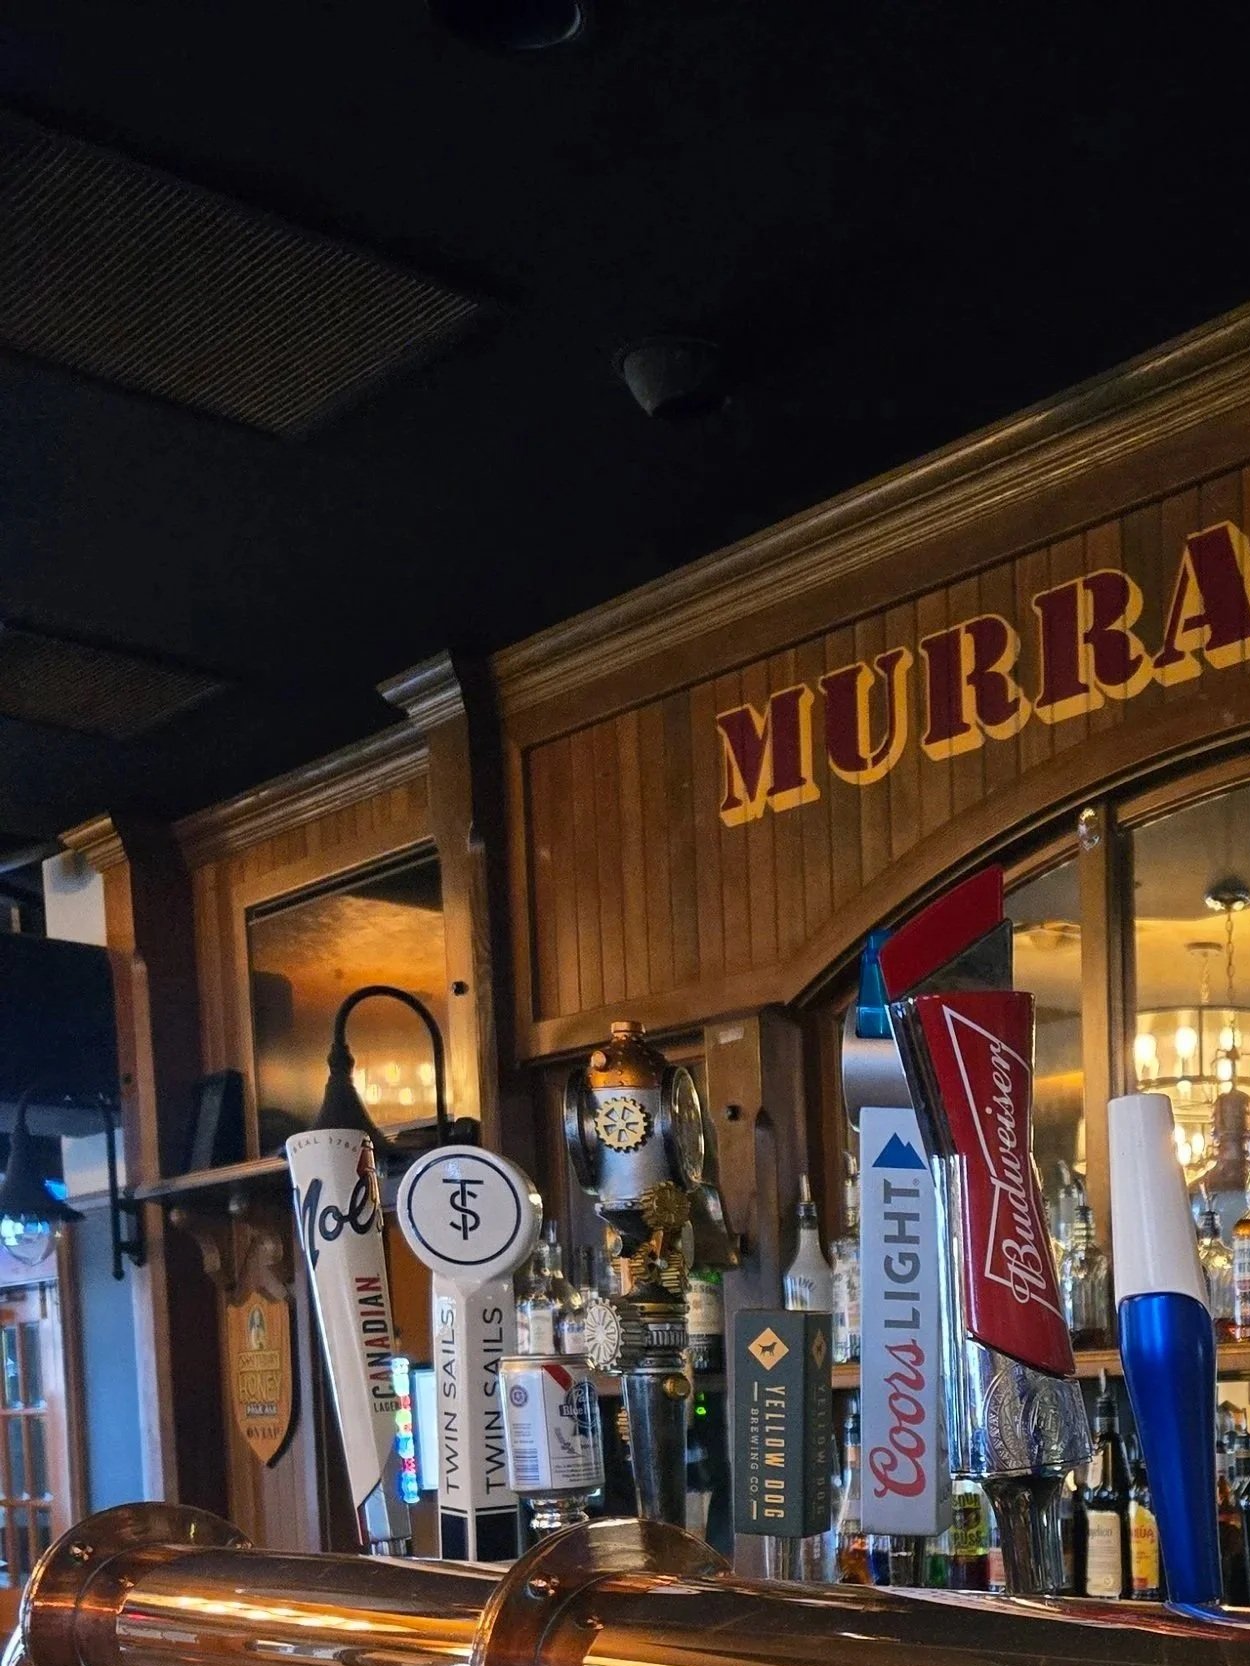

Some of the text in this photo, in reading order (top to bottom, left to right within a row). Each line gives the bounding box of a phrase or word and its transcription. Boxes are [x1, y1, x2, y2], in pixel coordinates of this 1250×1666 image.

[986, 1040, 1046, 1304] Budweiser
[355, 1277, 396, 1399] CANADIAN
[441, 1308, 460, 1494] TWIN SAILS
[483, 1306, 506, 1496] TWIN SAILS
[869, 1178, 927, 1500] Coors LIGHT
[750, 1408, 759, 1470] BREWING
[764, 1385, 786, 1519] YELLOW DOG
